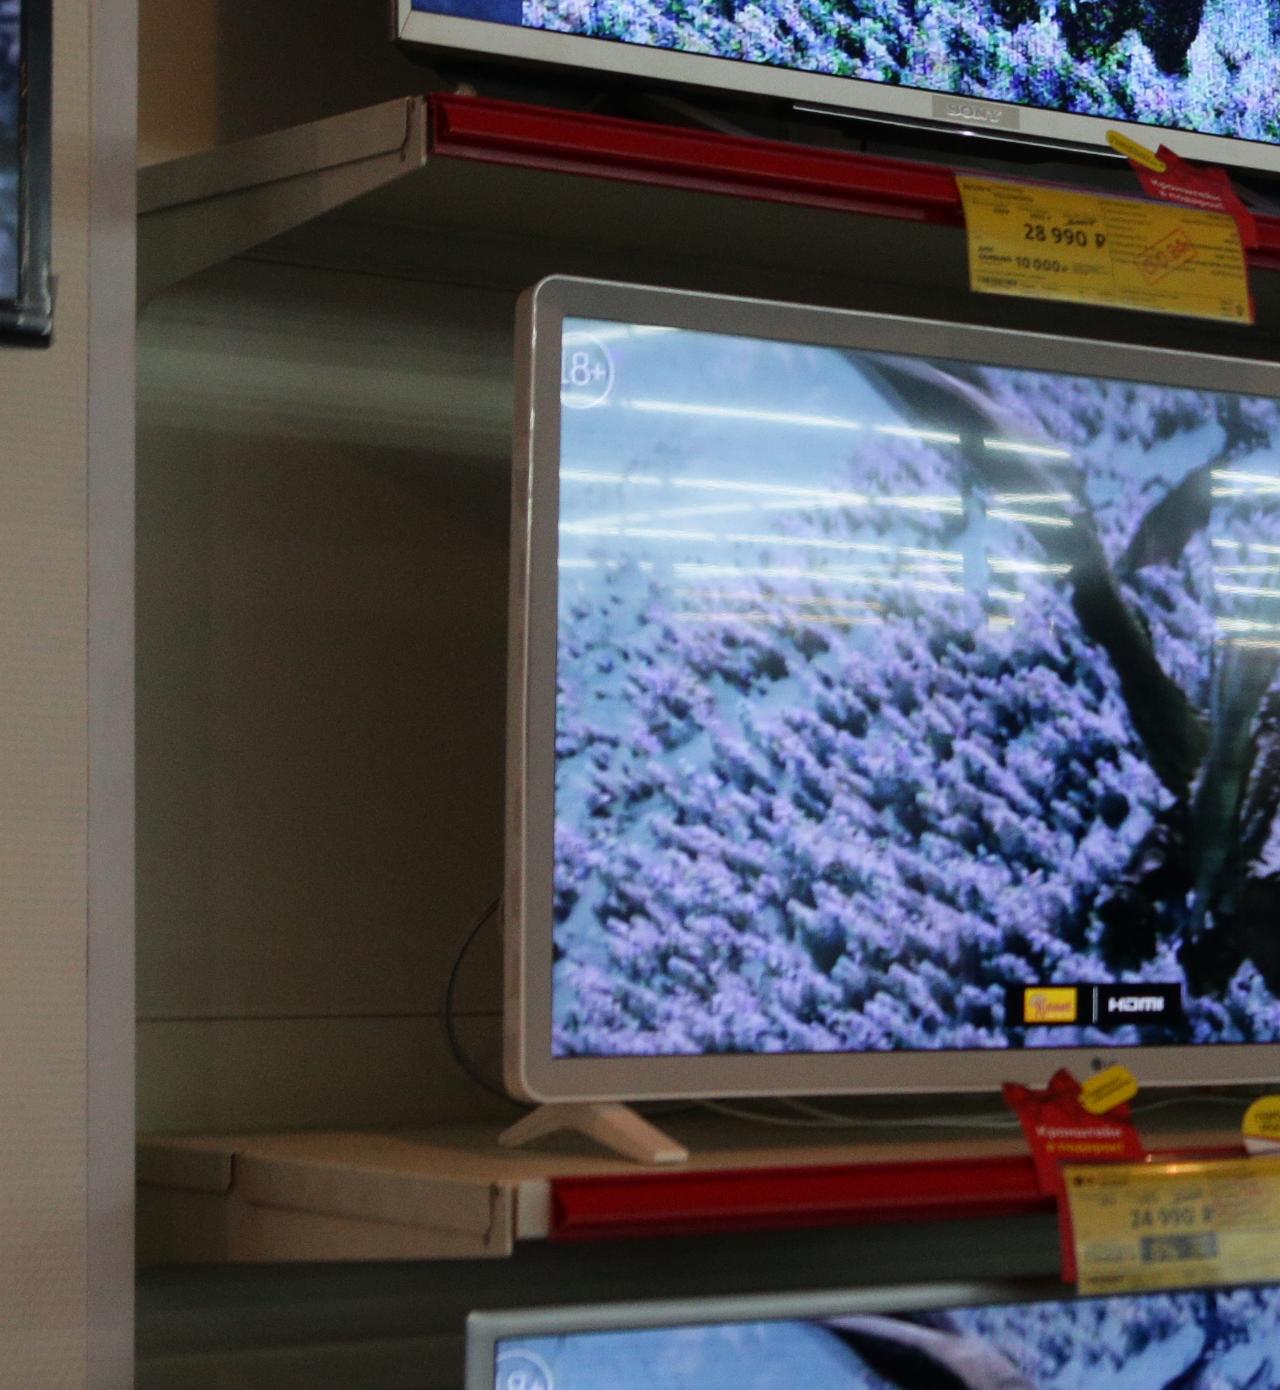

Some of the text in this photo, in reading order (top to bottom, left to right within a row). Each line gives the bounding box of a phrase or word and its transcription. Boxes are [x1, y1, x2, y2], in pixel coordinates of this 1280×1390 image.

[946, 103, 1002, 123] SONY
[1024, 223, 1046, 242] 28
[1051, 227, 1087, 247] 990
[1108, 996, 1164, 1013] HDMI
